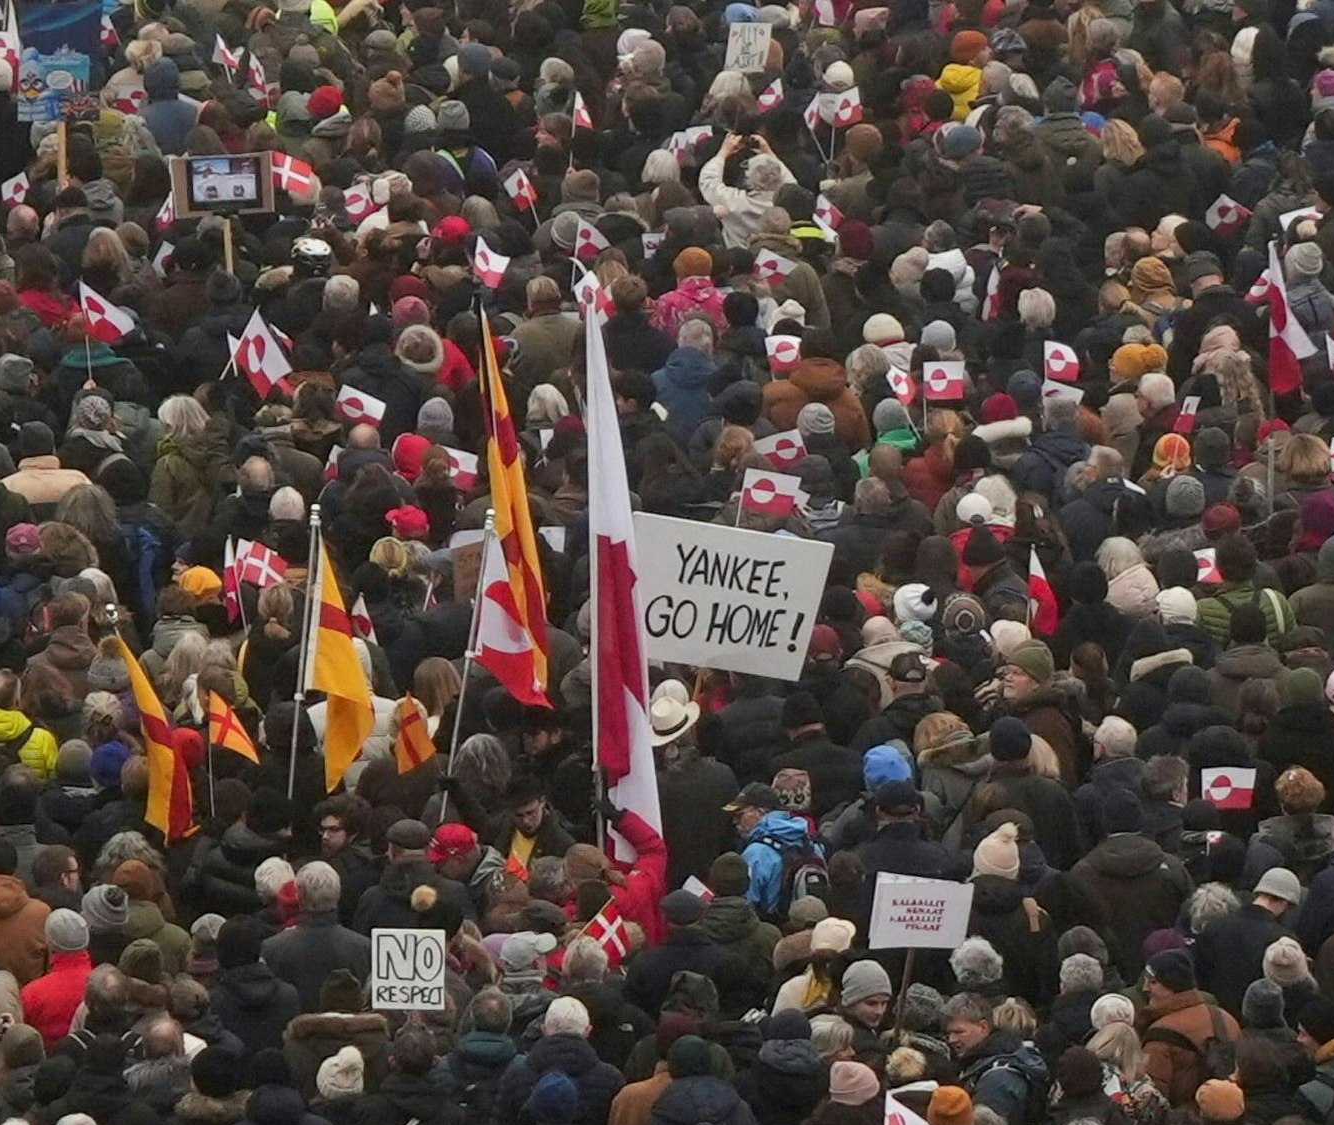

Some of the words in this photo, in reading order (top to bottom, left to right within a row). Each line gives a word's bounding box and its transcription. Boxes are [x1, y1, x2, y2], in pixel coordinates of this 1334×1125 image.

[676, 543, 789, 600] YANKEE,
[645, 595, 698, 638] GO
[377, 934, 443, 982] NO
[376, 985, 443, 1005] RESPECT
